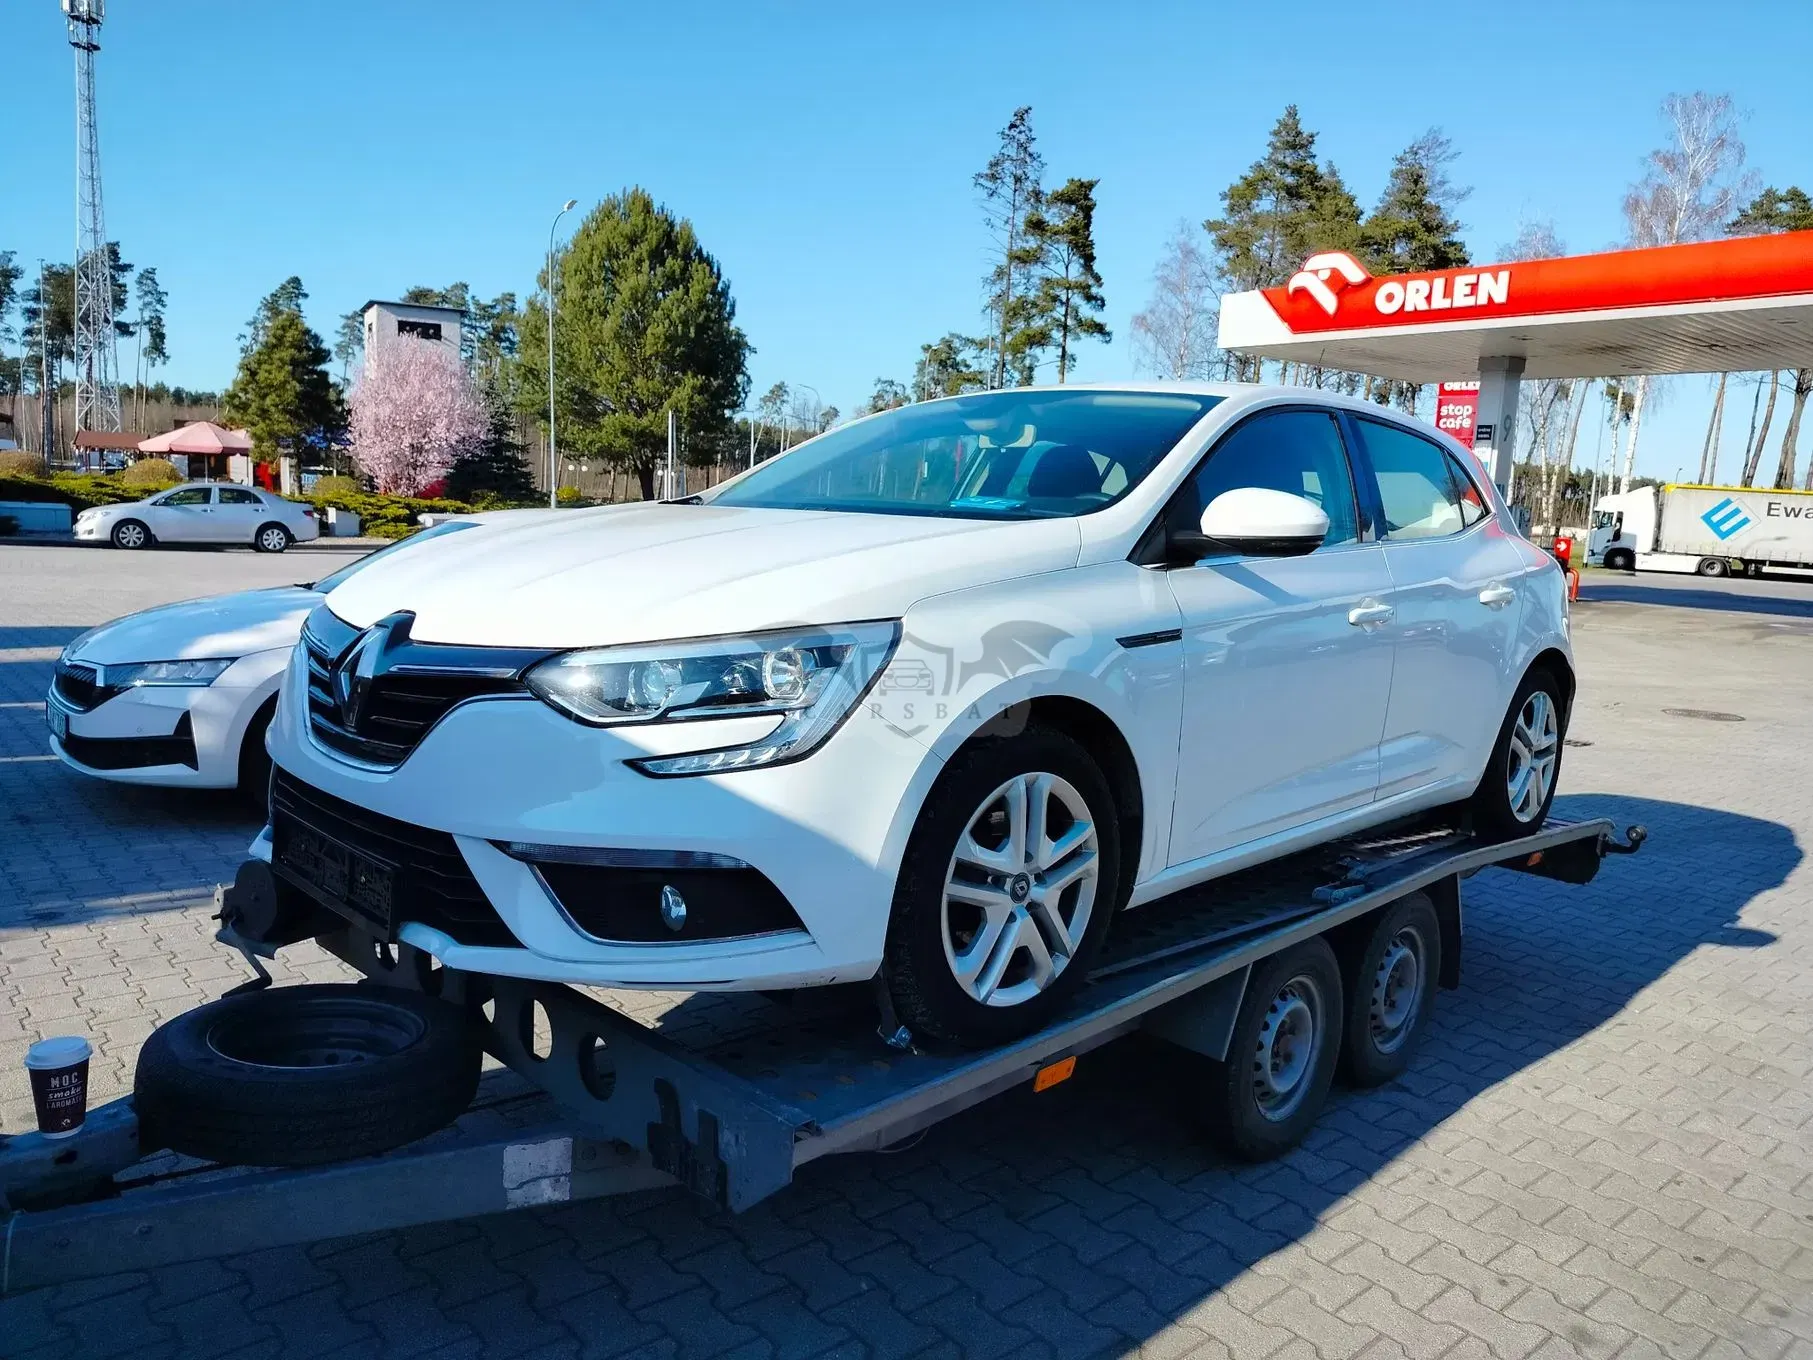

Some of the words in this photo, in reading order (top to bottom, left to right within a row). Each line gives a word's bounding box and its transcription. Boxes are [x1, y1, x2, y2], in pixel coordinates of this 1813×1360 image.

[1375, 271, 1510, 315] ORLEN
[1440, 403, 1473, 418] stop
[1439, 416, 1472, 430] cafe
[1503, 414, 1513, 442] 9
[50, 1071, 78, 1088] MOC
